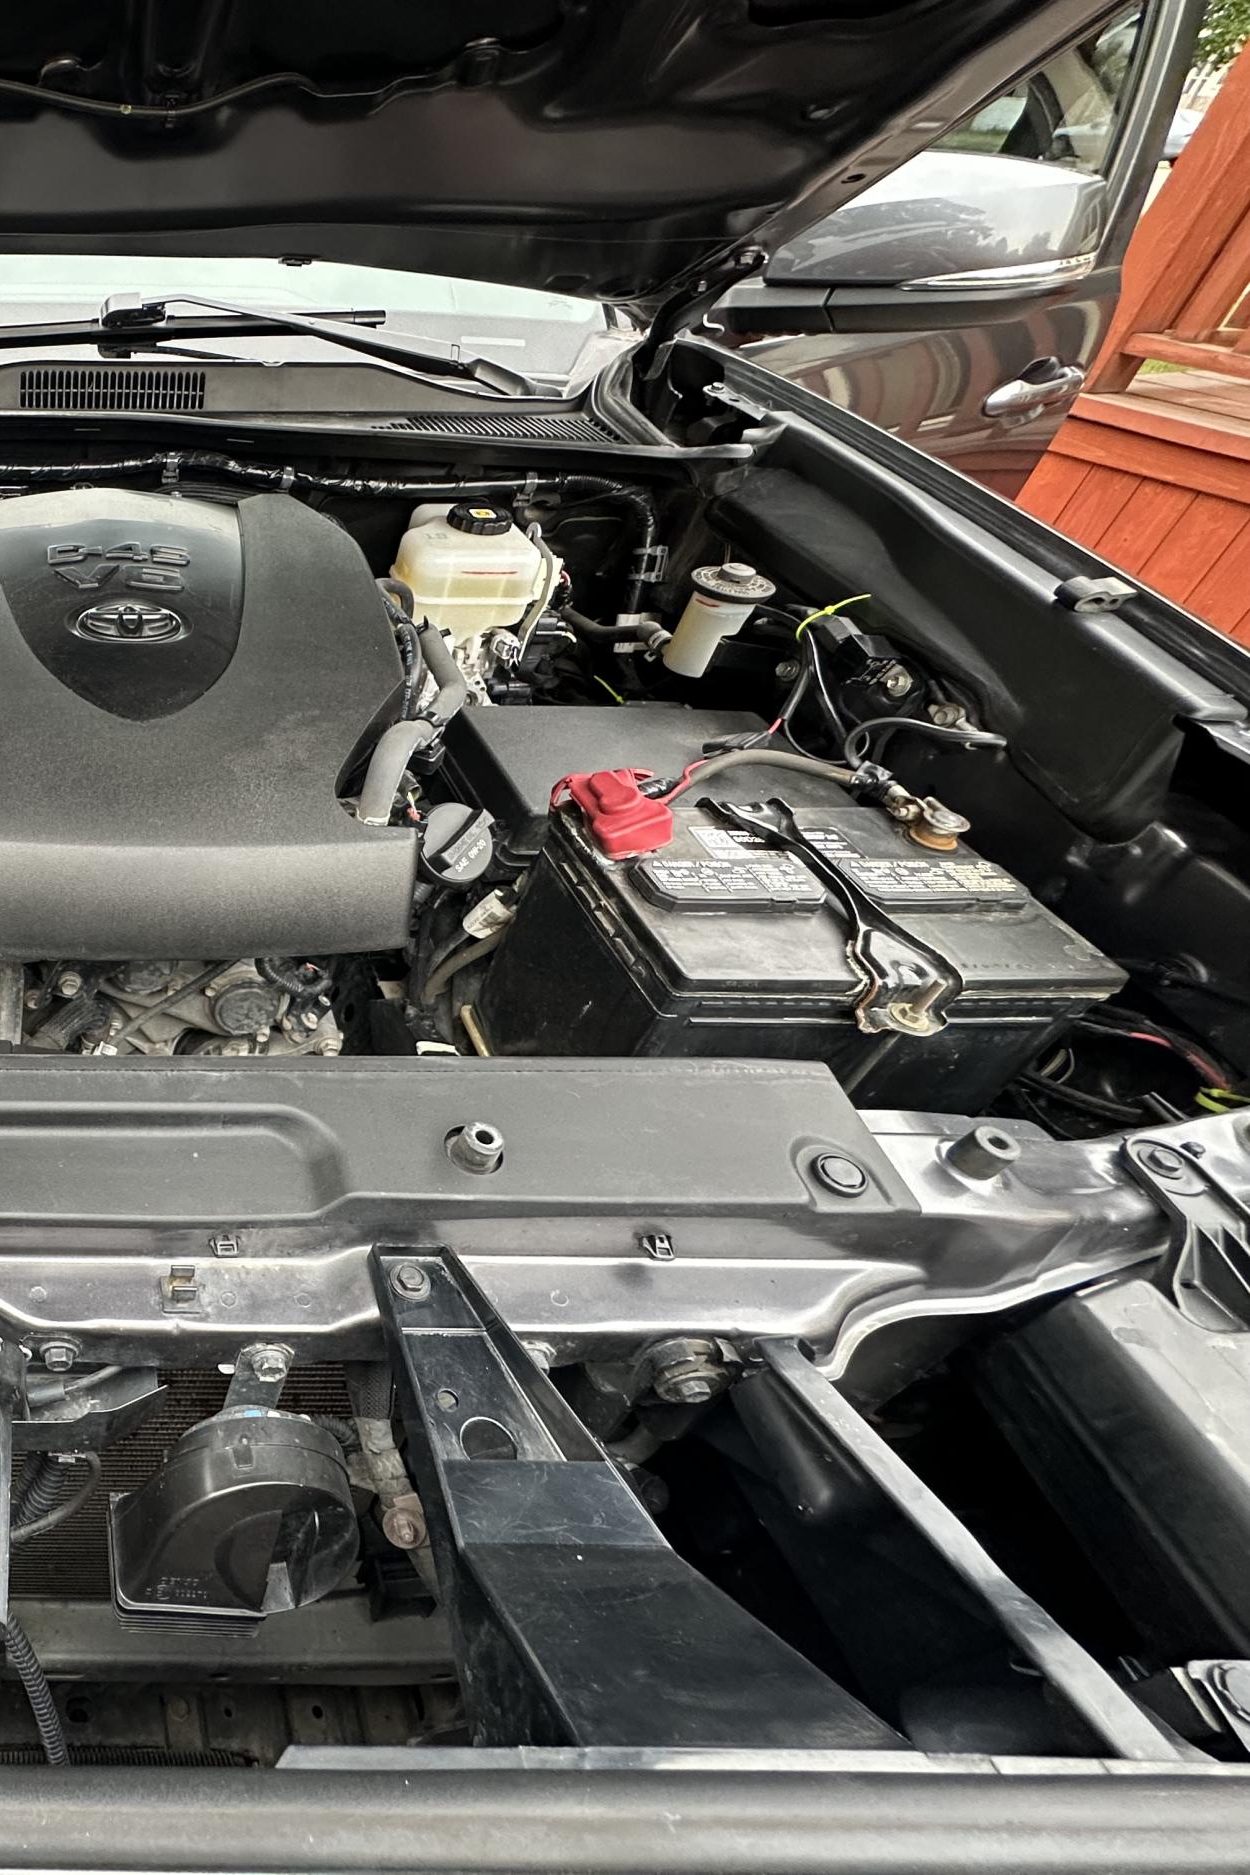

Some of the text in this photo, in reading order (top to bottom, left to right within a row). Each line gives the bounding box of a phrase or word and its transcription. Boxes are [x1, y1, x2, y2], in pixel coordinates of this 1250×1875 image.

[48, 542, 190, 566] D-4S
[54, 563, 185, 591] V6
[454, 838, 487, 873] SAE 0W-20
